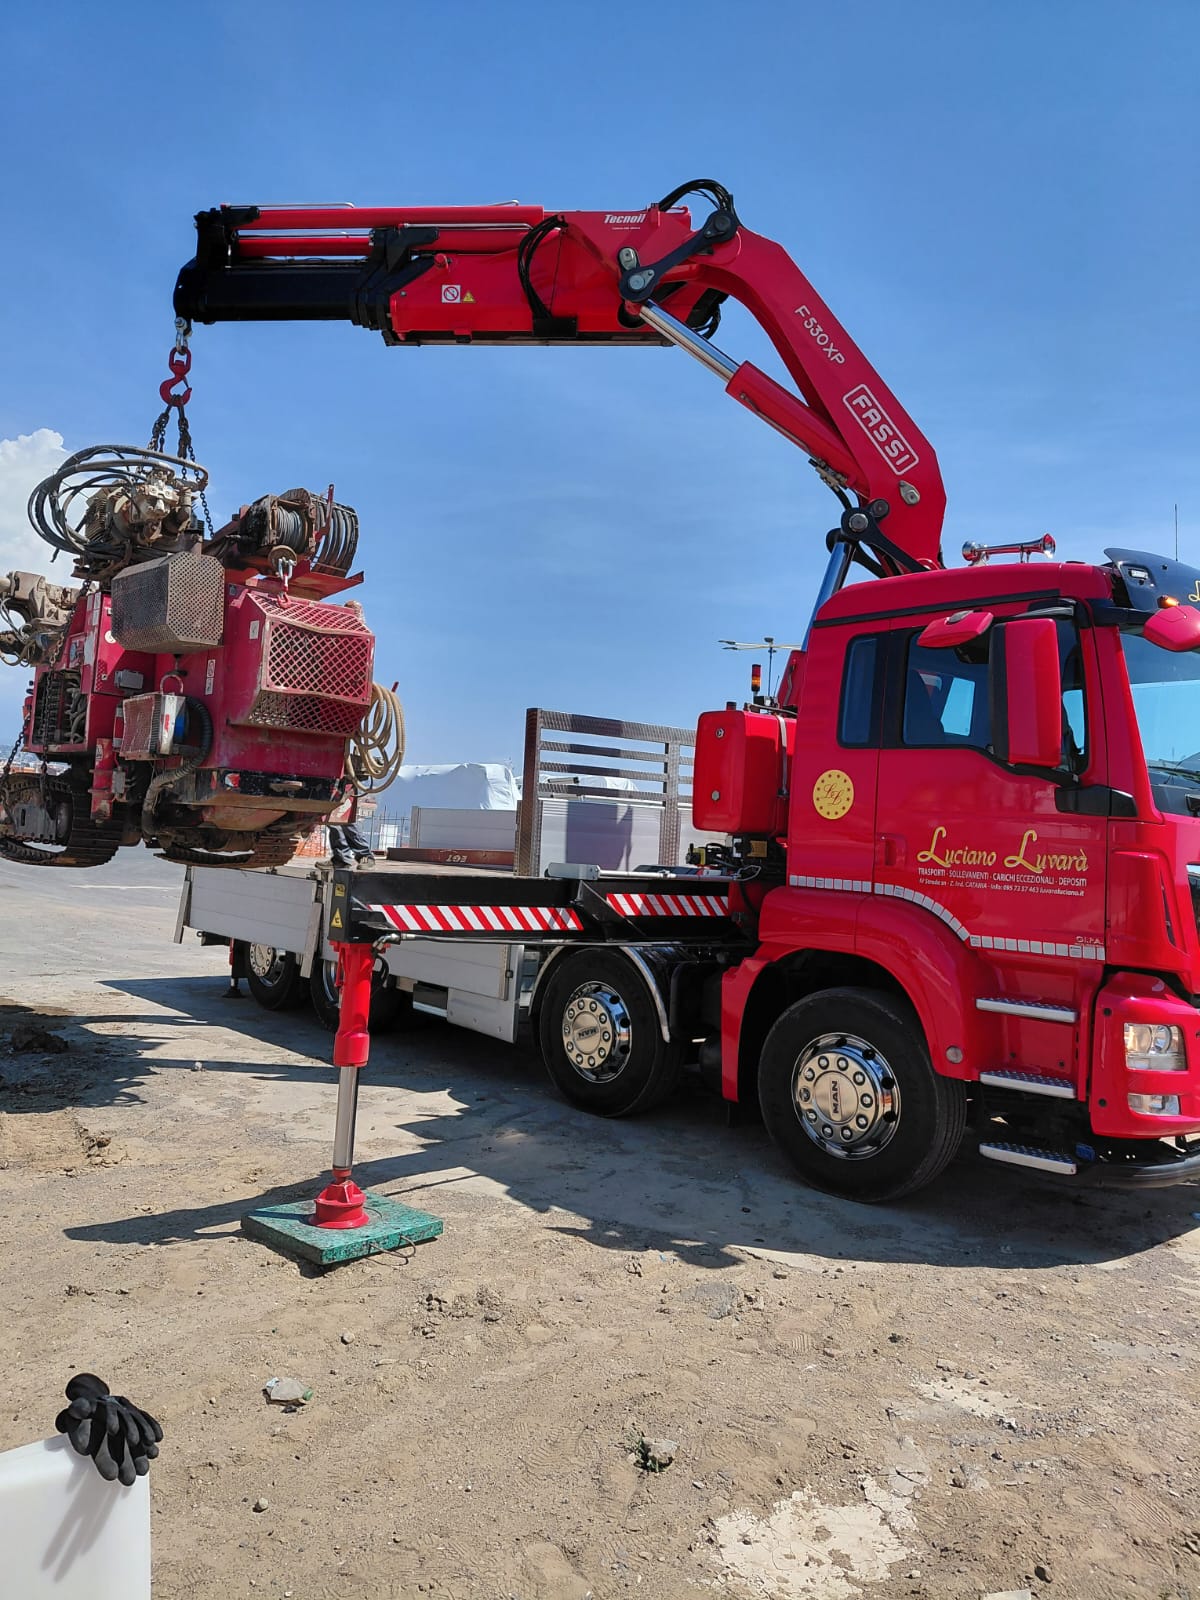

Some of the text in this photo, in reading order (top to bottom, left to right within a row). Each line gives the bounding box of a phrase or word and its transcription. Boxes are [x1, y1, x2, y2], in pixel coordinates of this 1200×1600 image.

[604, 213, 647, 224] Tecnoil
[852, 393, 911, 467] FASSI
[916, 826, 1089, 874] Luciano Luvarà
[918, 867, 1087, 887] TRASPORTI SOLLEVAMENTI CARICHI ECCEZIONALI DEPOSITI
[965, 881, 987, 889] CATANIA
[831, 1080, 839, 1114] MAN
